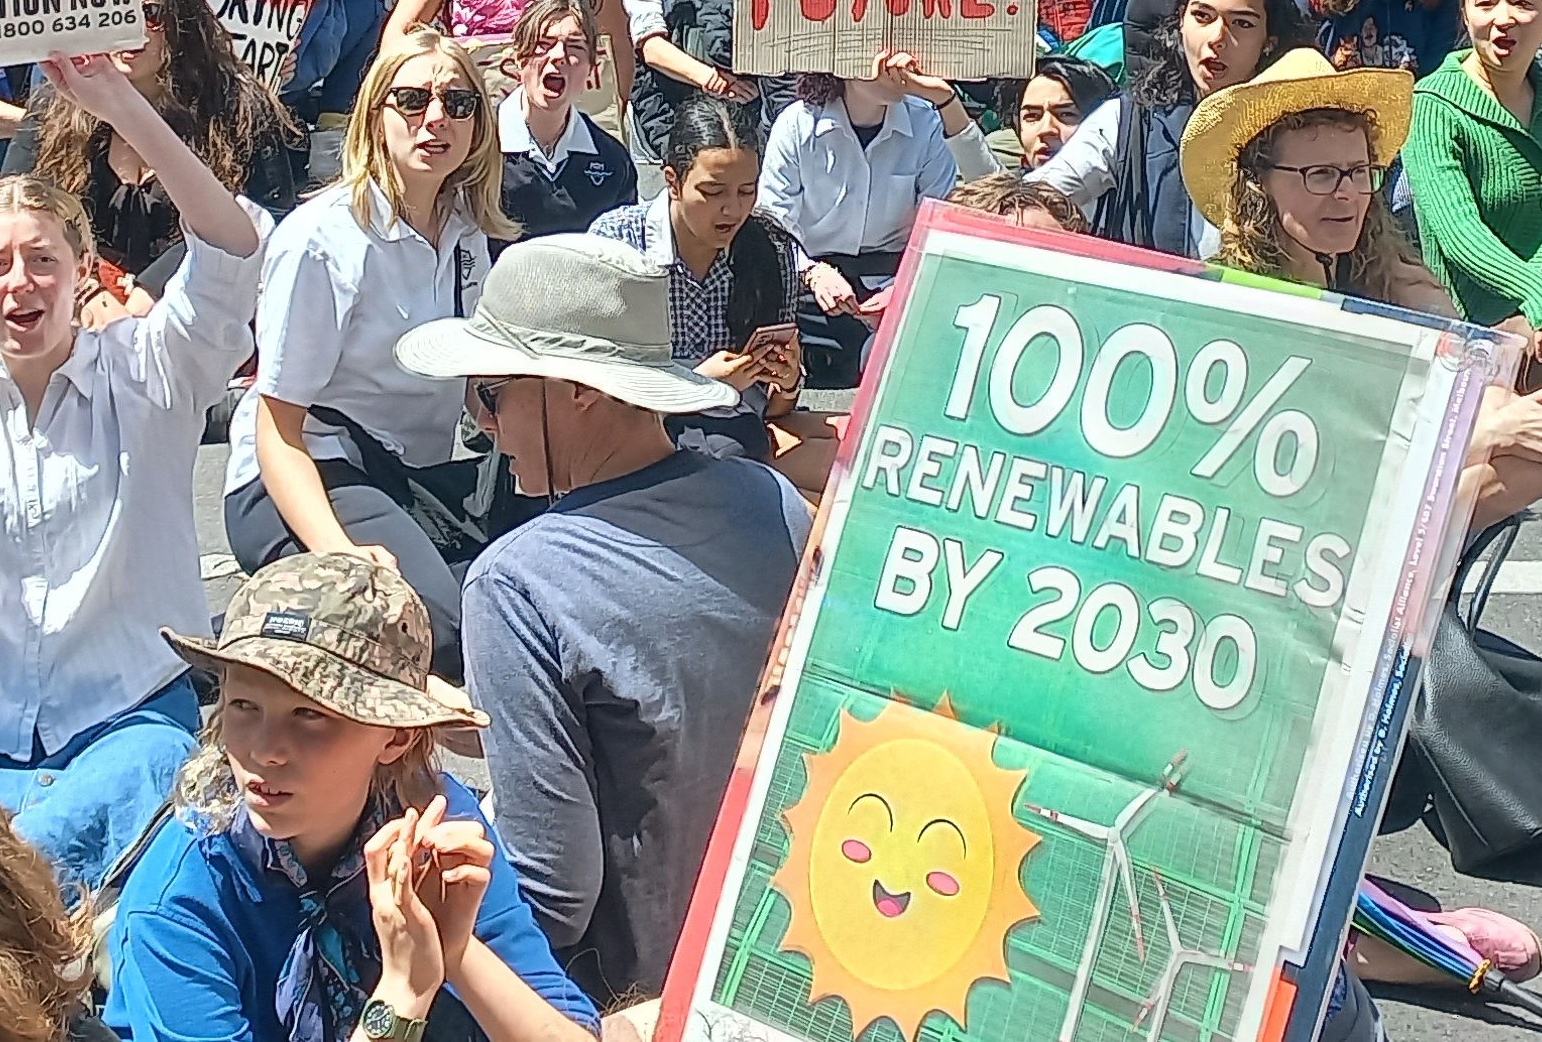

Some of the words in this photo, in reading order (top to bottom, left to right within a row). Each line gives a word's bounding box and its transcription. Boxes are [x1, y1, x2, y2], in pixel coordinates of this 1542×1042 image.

[52, 13, 92, 35] 634
[97, 8, 138, 29] 206
[942, 293, 1322, 501] 100%
[862, 427, 1354, 609] RENEWABLES
[874, 525, 1004, 630] BY
[1006, 564, 1259, 711] 2030
